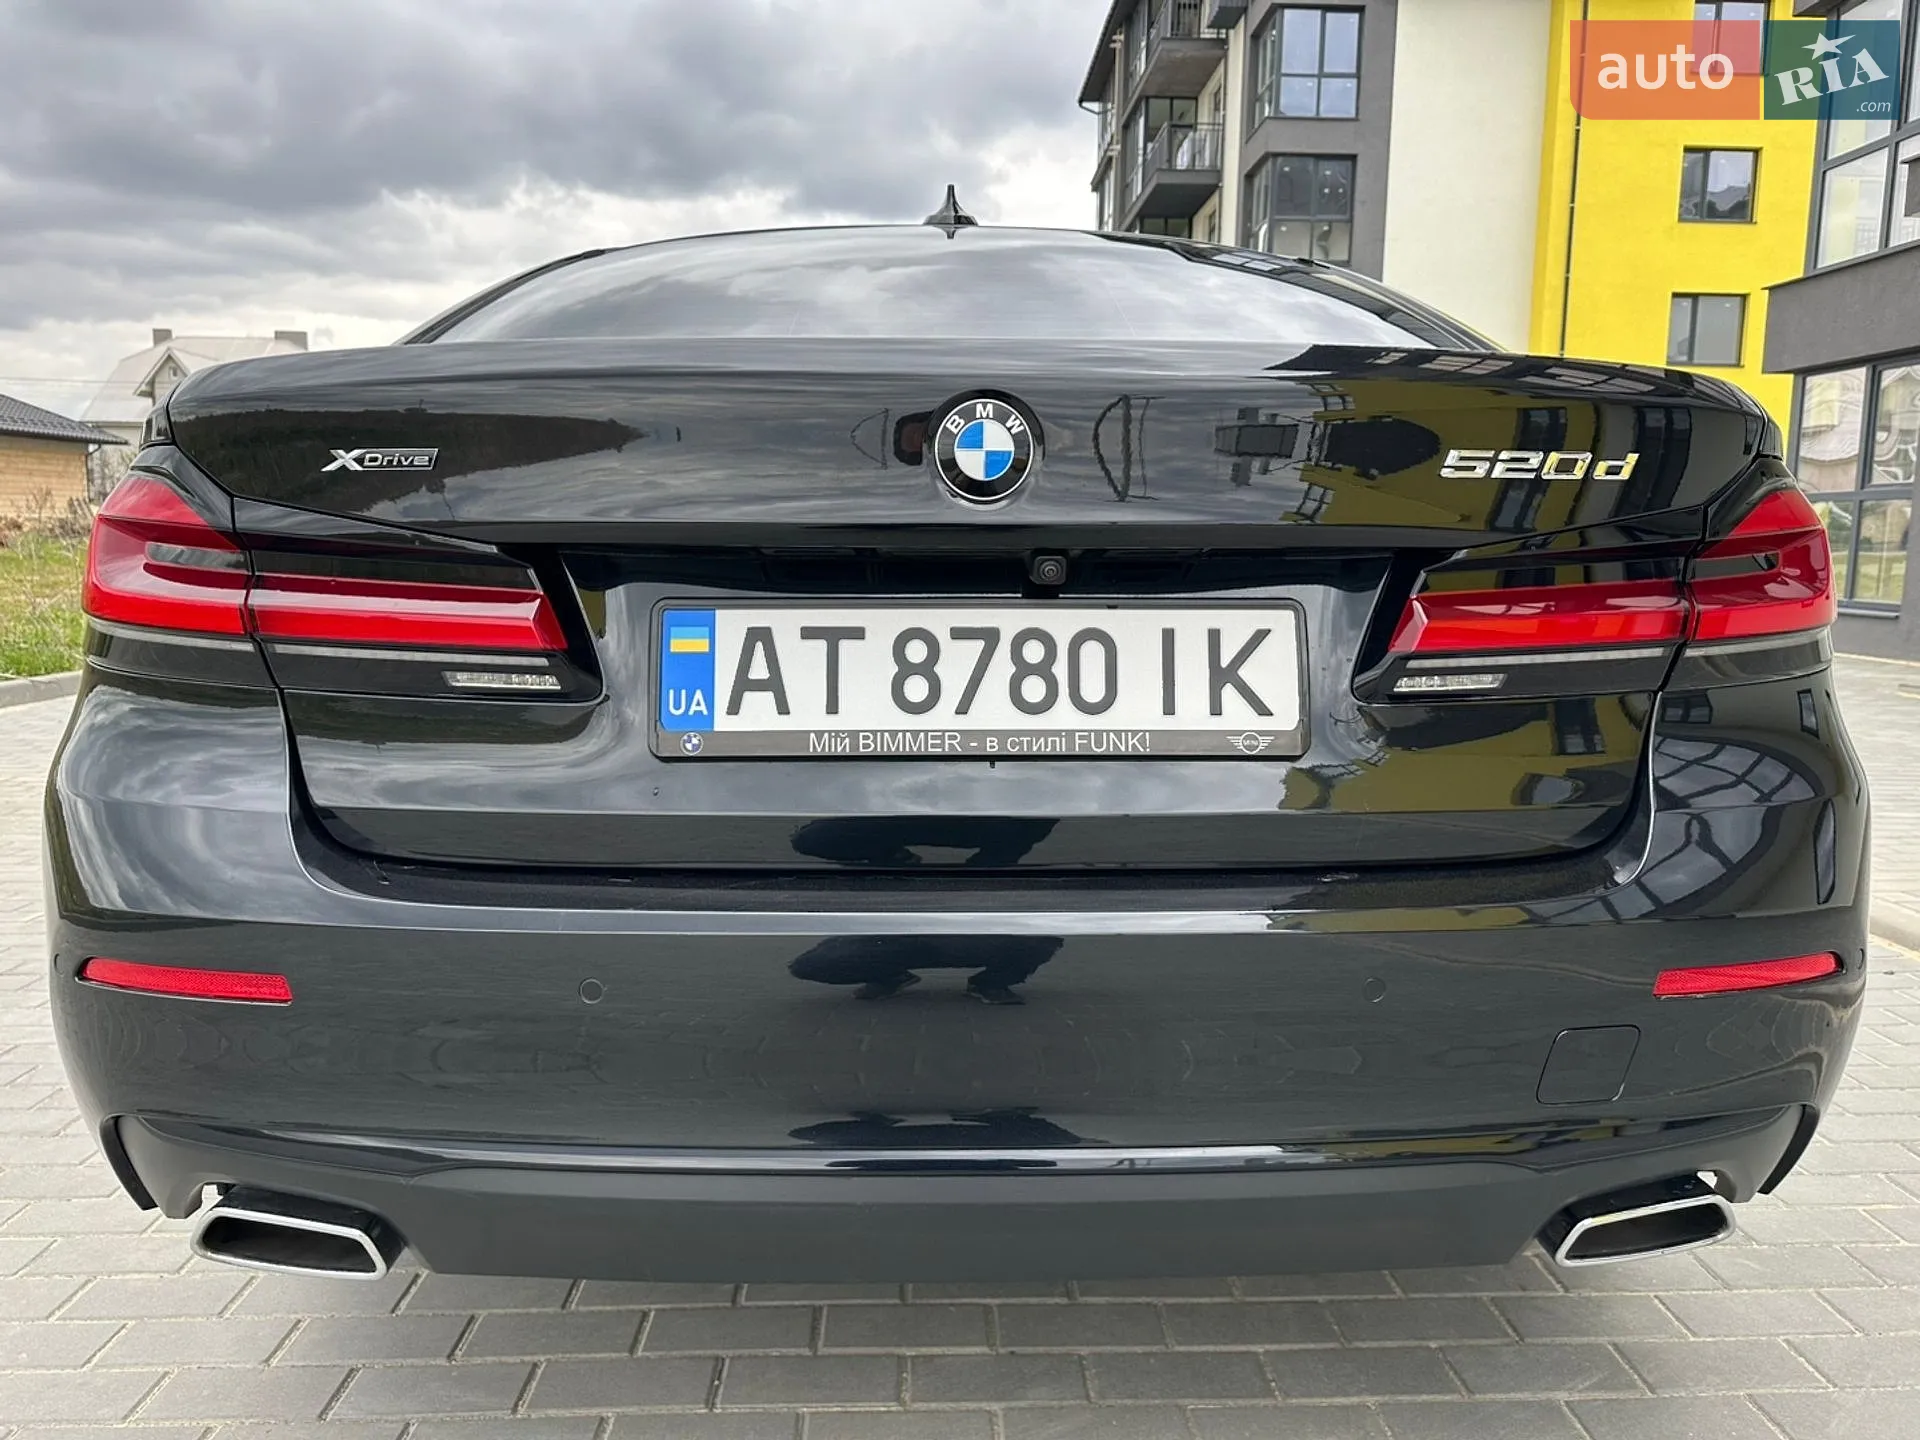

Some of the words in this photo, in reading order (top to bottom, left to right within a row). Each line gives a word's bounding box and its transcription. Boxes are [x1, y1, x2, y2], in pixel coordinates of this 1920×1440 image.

[945, 403, 1025, 435] BMW
[1440, 449, 1640, 480] 520d
[726, 627, 866, 716] AT
[891, 626, 1118, 716] 8780
[1162, 628, 1275, 717] IK
[668, 689, 709, 716] UA
[808, 732, 851, 753] Мій
[858, 732, 963, 753] BIMMER
[1006, 732, 1067, 753] стилі
[1074, 732, 1151, 753] FUNK!
